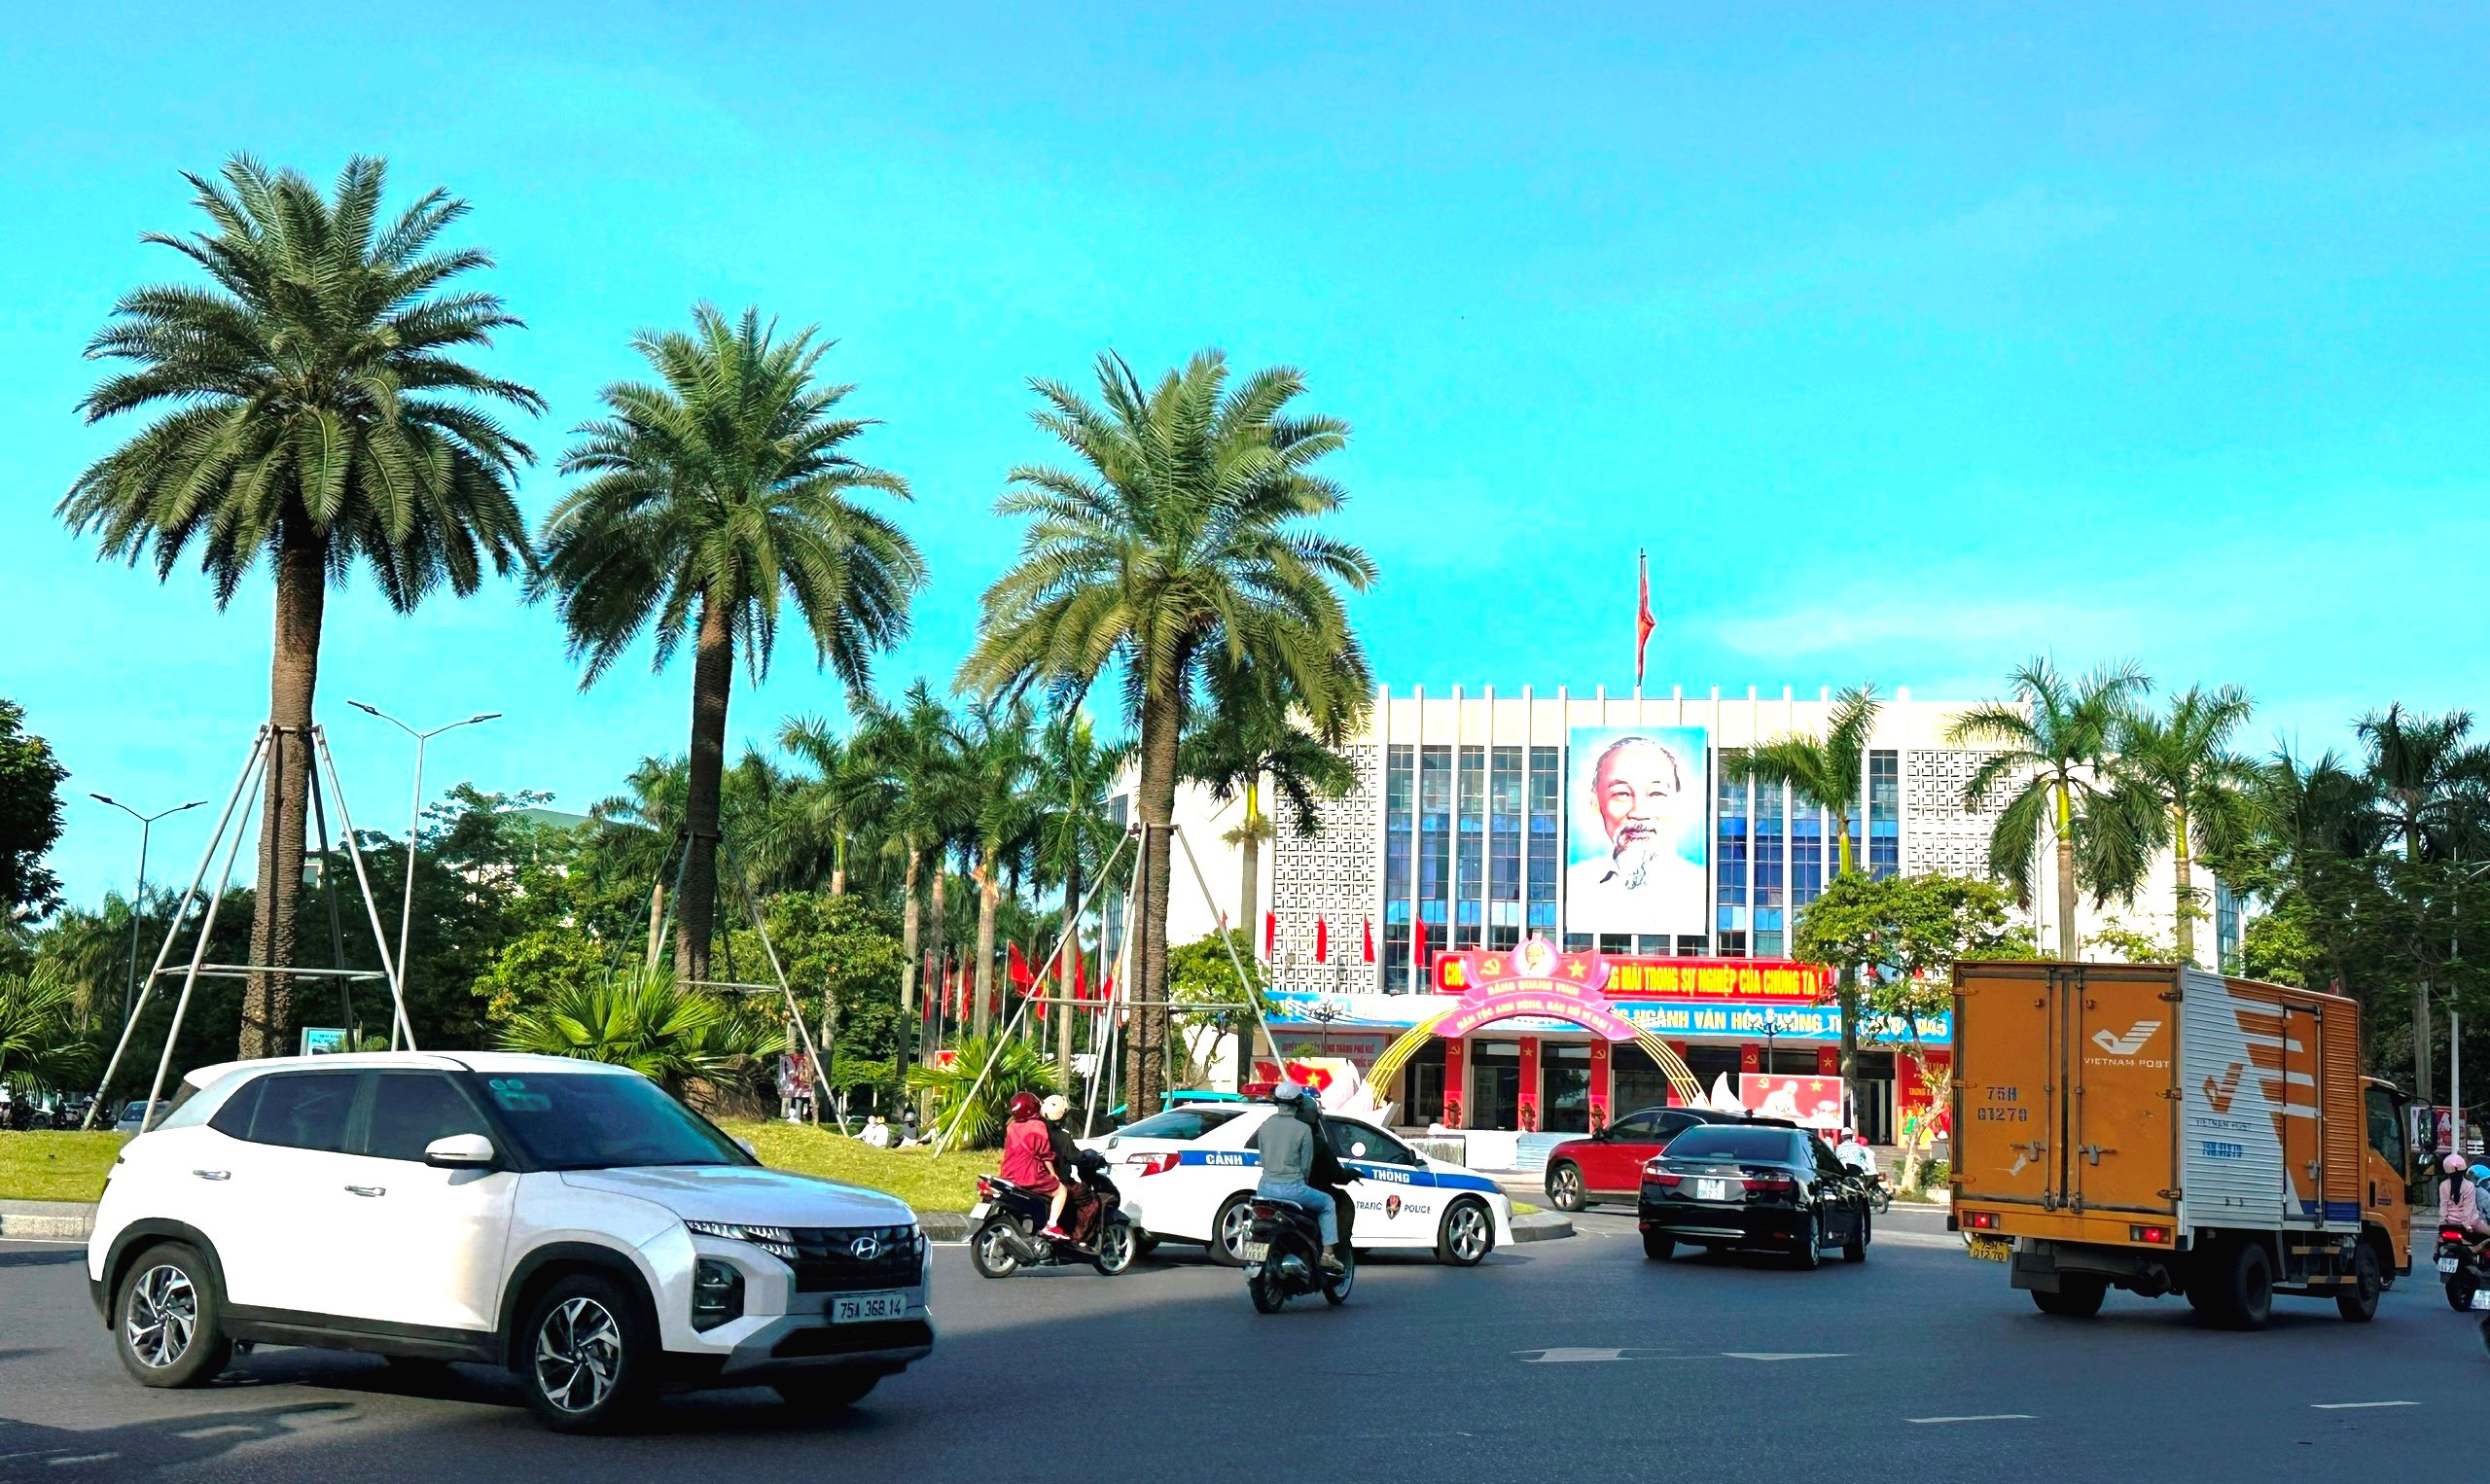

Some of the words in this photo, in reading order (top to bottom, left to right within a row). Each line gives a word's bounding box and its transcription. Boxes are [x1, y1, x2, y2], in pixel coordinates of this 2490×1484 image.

[1621, 963, 1642, 990] MÃI
[1644, 967, 1679, 991] TRONG
[1681, 968, 1696, 996] SỰ
[1698, 965, 1737, 996] NGHIỆP
[1739, 966, 1761, 994] CỦA
[1763, 965, 1798, 995] CHÚNG
[1801, 970, 1816, 995] TA
[1517, 979, 1553, 991] QUANG
[1556, 982, 1581, 997] VINH
[1693, 1007, 1726, 1029] VĂN
[2083, 1057, 2135, 1067] VIETNAM
[2139, 1059, 2170, 1069] POST
[1986, 1086, 2017, 1102] 75H
[1205, 1150, 1243, 1165] CẢNH
[1372, 1167, 1410, 1184] THÔNG
[1404, 1204, 1432, 1215] POLICE
